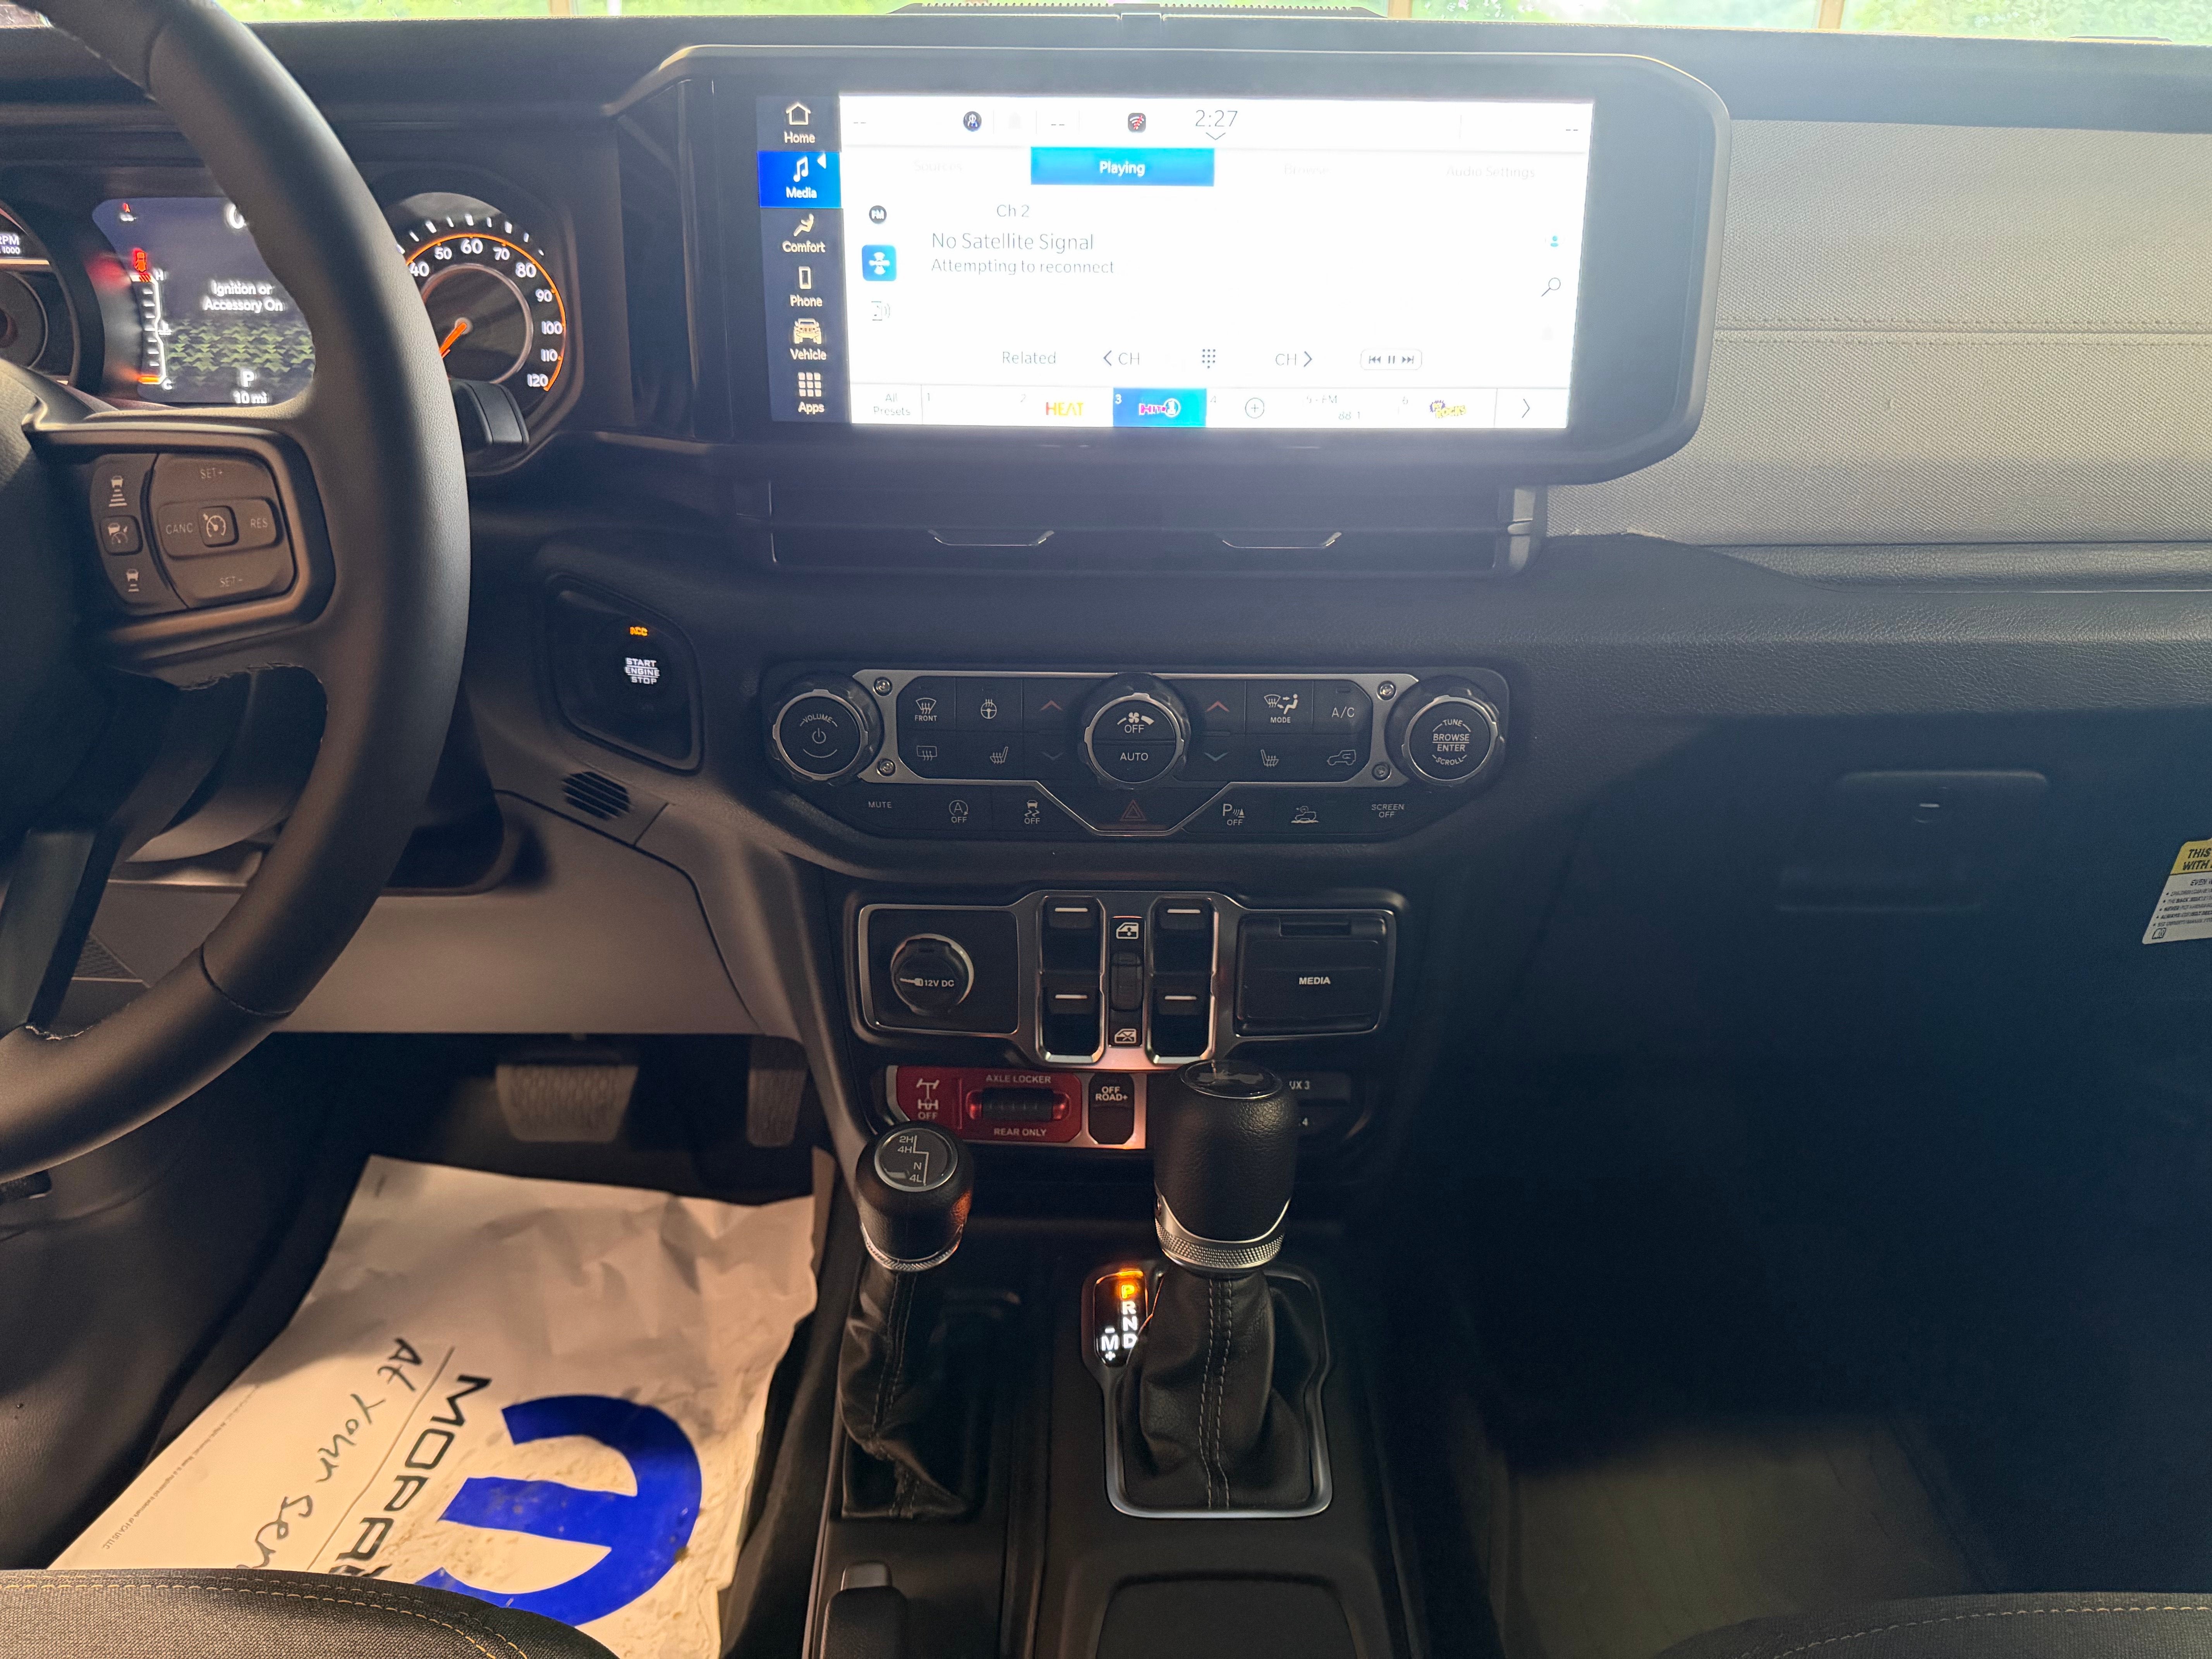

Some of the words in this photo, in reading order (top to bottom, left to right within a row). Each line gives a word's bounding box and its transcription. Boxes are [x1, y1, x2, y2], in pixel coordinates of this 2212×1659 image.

[1195, 110, 1238, 127] 2:27
[784, 132, 816, 143] Home
[1100, 161, 1145, 177] Playing
[1446, 166, 1482, 177] Audio
[1486, 167, 1535, 180] Settings
[786, 187, 817, 199] Media
[996, 204, 1016, 218] Ch
[1021, 204, 1030, 218] 2
[0, 235, 20, 245] RPM
[782, 240, 826, 252] Comfort
[932, 233, 957, 250] No
[962, 232, 1034, 250] Satellite
[1039, 233, 1094, 254] Signal
[3, 246, 21, 254] 1000
[461, 239, 483, 254] 60
[434, 247, 452, 260] 50
[493, 247, 510, 261] 70
[409, 261, 429, 277] 40
[515, 262, 537, 278] 80
[931, 258, 1016, 276] Attempting
[1021, 260, 1035, 273] to
[1040, 260, 1114, 273] reconnect
[155, 270, 164, 281] H
[213, 281, 256, 297] Ignition
[258, 282, 272, 295] or
[536, 289, 552, 302] 90
[790, 295, 823, 307] Phone
[204, 297, 263, 314] Accessory
[264, 298, 284, 311] On
[541, 321, 563, 335] 100
[541, 349, 558, 362] 110
[790, 349, 827, 360] Vehicle
[1002, 351, 1056, 364] Related
[1118, 352, 1140, 365] CH
[1275, 353, 1297, 366] CH
[162, 380, 172, 390] C
[242, 370, 255, 388] P
[527, 374, 549, 387] 120
[235, 391, 249, 404] 10
[252, 392, 268, 404] mi
[885, 393, 898, 402] All
[1115, 394, 1122, 404] 3
[798, 402, 824, 414] Apps
[873, 405, 911, 416] Presets
[1046, 402, 1084, 416] HEAT
[166, 522, 193, 534] CANC
[251, 518, 268, 529] RES
[630, 627, 648, 636] ACC
[625, 658, 656, 667] START
[625, 666, 660, 677] ENGINE
[631, 677, 657, 685] STOP
[1332, 706, 1355, 718] A/C
[803, 714, 833, 723] VOLUME
[1443, 719, 1463, 727] TUNE
[1124, 725, 1144, 733] OFF
[1120, 752, 1148, 761] AUTO
[1436, 756, 1463, 765] SCROLL
[2188, 848, 2212, 859] THIS
[2183, 860, 2210, 871] WITH
[942, 979, 954, 988] DC
[1299, 977, 1331, 985] MEDIA
[1013, 1075, 1051, 1084] LOCKER
[1304, 1080, 1310, 1090] 3
[1022, 1128, 1046, 1137] ONLY
[909, 1174, 922, 1182] 4L
[1121, 1285, 1135, 1299] P
[1122, 1301, 1136, 1315] R
[1123, 1316, 1137, 1331] N
[1101, 1334, 1119, 1351] M
[1123, 1333, 1137, 1348] D
[378, 1338, 422, 1392] At
[316, 1394, 386, 1483] Your
[120, 1522, 131, 1533] FCA
[236, 1495, 313, 1568] Ser
[112, 1532, 121, 1541] US
